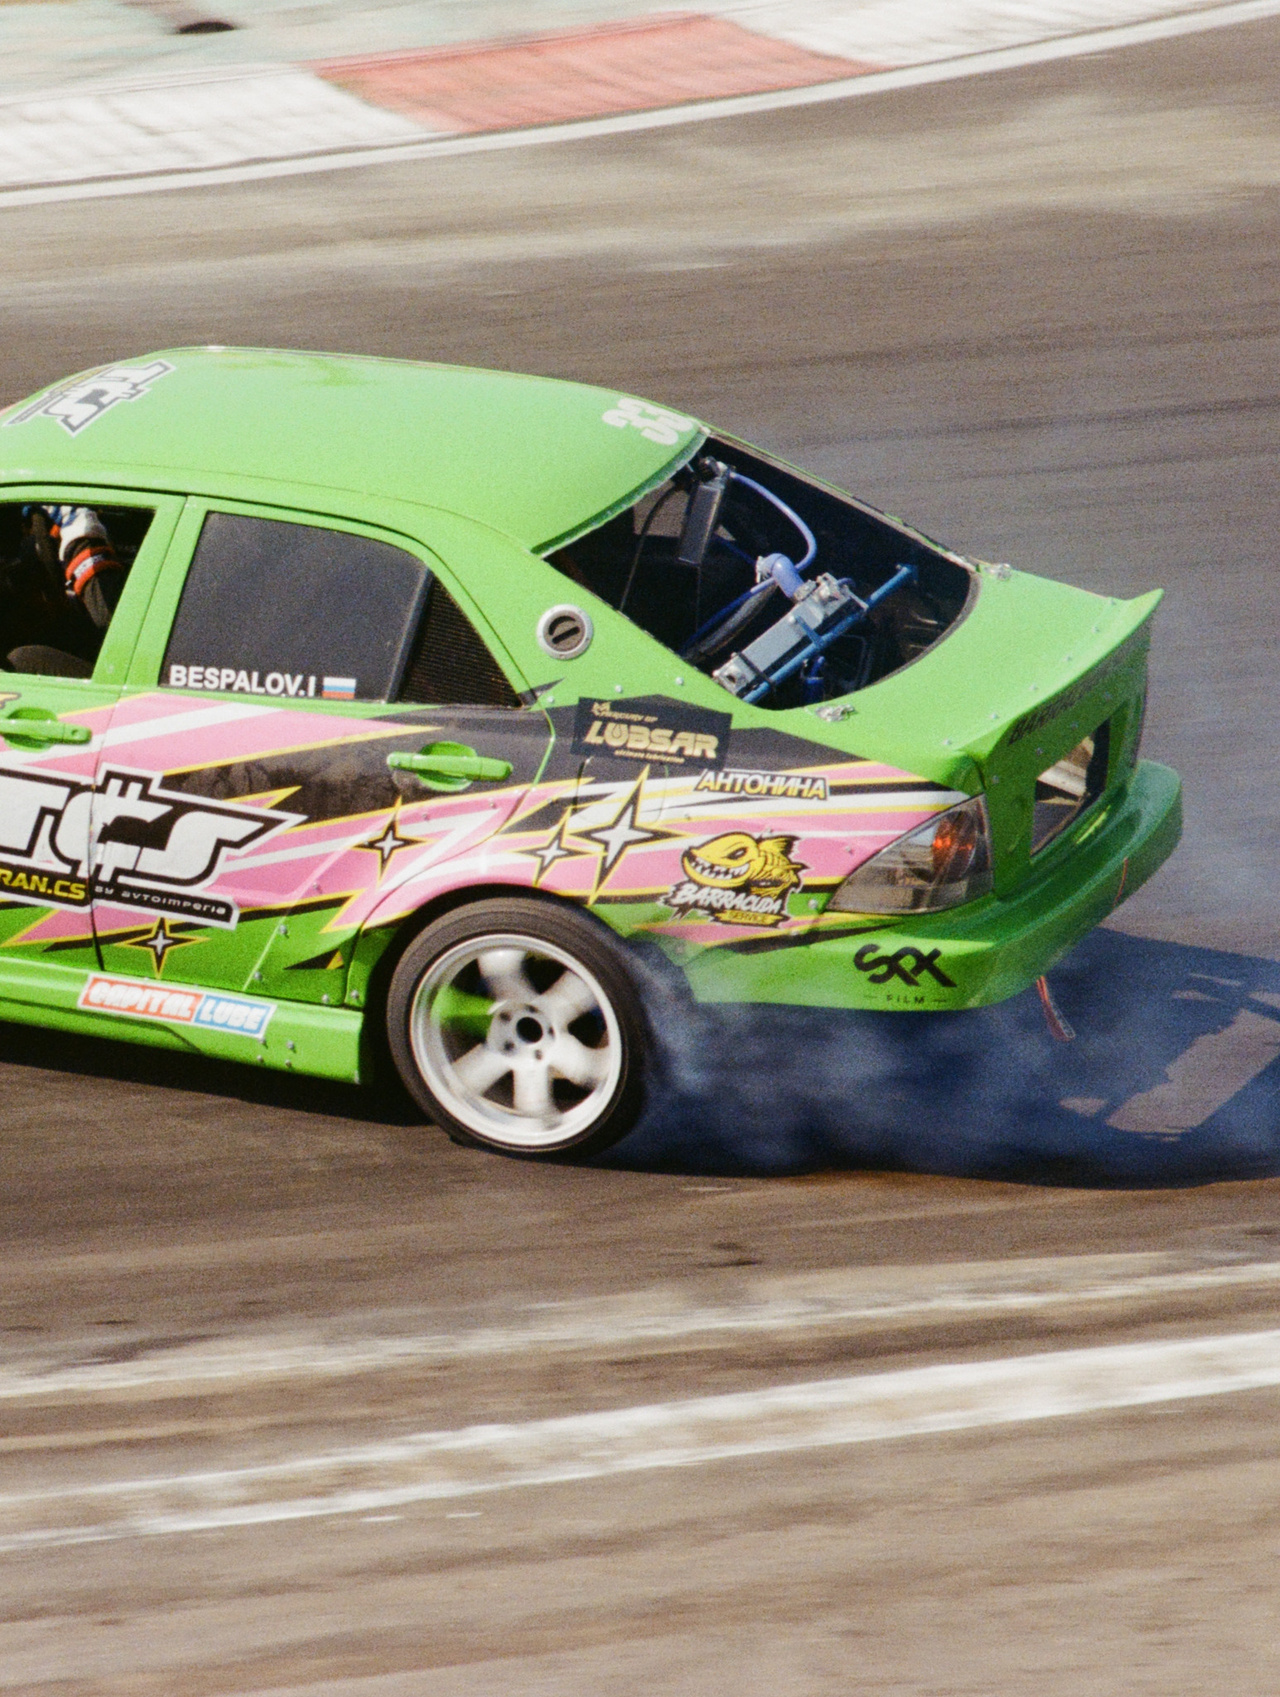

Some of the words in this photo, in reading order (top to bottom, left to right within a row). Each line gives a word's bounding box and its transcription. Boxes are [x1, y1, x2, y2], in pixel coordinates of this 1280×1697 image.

[584, 721, 719, 759] LUBSAR
[697, 772, 825, 799] АНТОНИНА
[671, 882, 782, 914] BARRACUDA
[89, 981, 197, 1018] CAPITAL
[199, 999, 267, 1031] LUBE
[887, 994, 925, 1004] FILM
